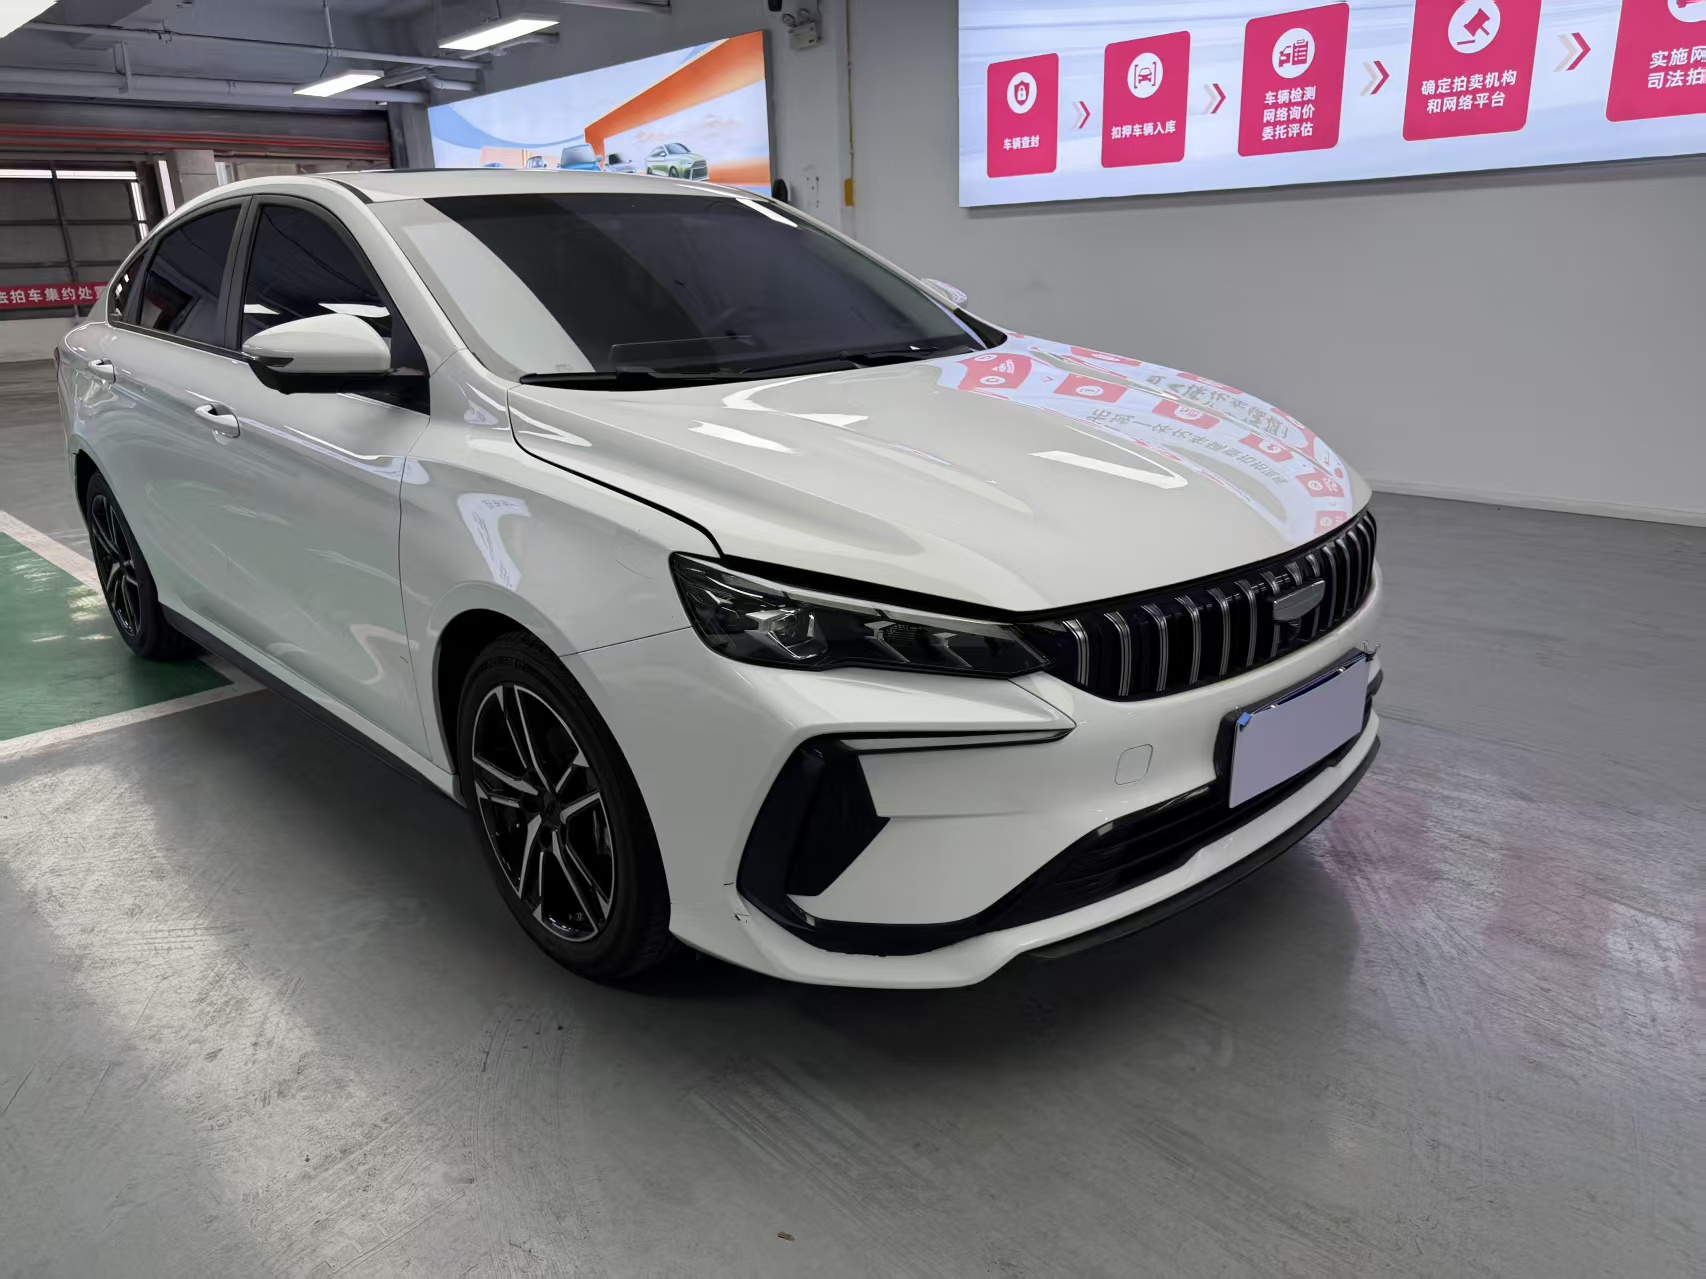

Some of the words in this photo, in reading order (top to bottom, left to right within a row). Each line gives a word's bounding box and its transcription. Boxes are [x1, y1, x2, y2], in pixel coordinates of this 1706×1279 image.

[1421, 70, 1517, 95] 确定拍卖机构
[1264, 85, 1316, 105] 车辆检测
[1426, 91, 1506, 115] 和网络平台
[1263, 103, 1315, 123] 网络询价
[1111, 119, 1177, 140] 扣押车辆入库
[1261, 121, 1313, 141] 委托评估
[1003, 135, 1040, 151] 车辆查封
